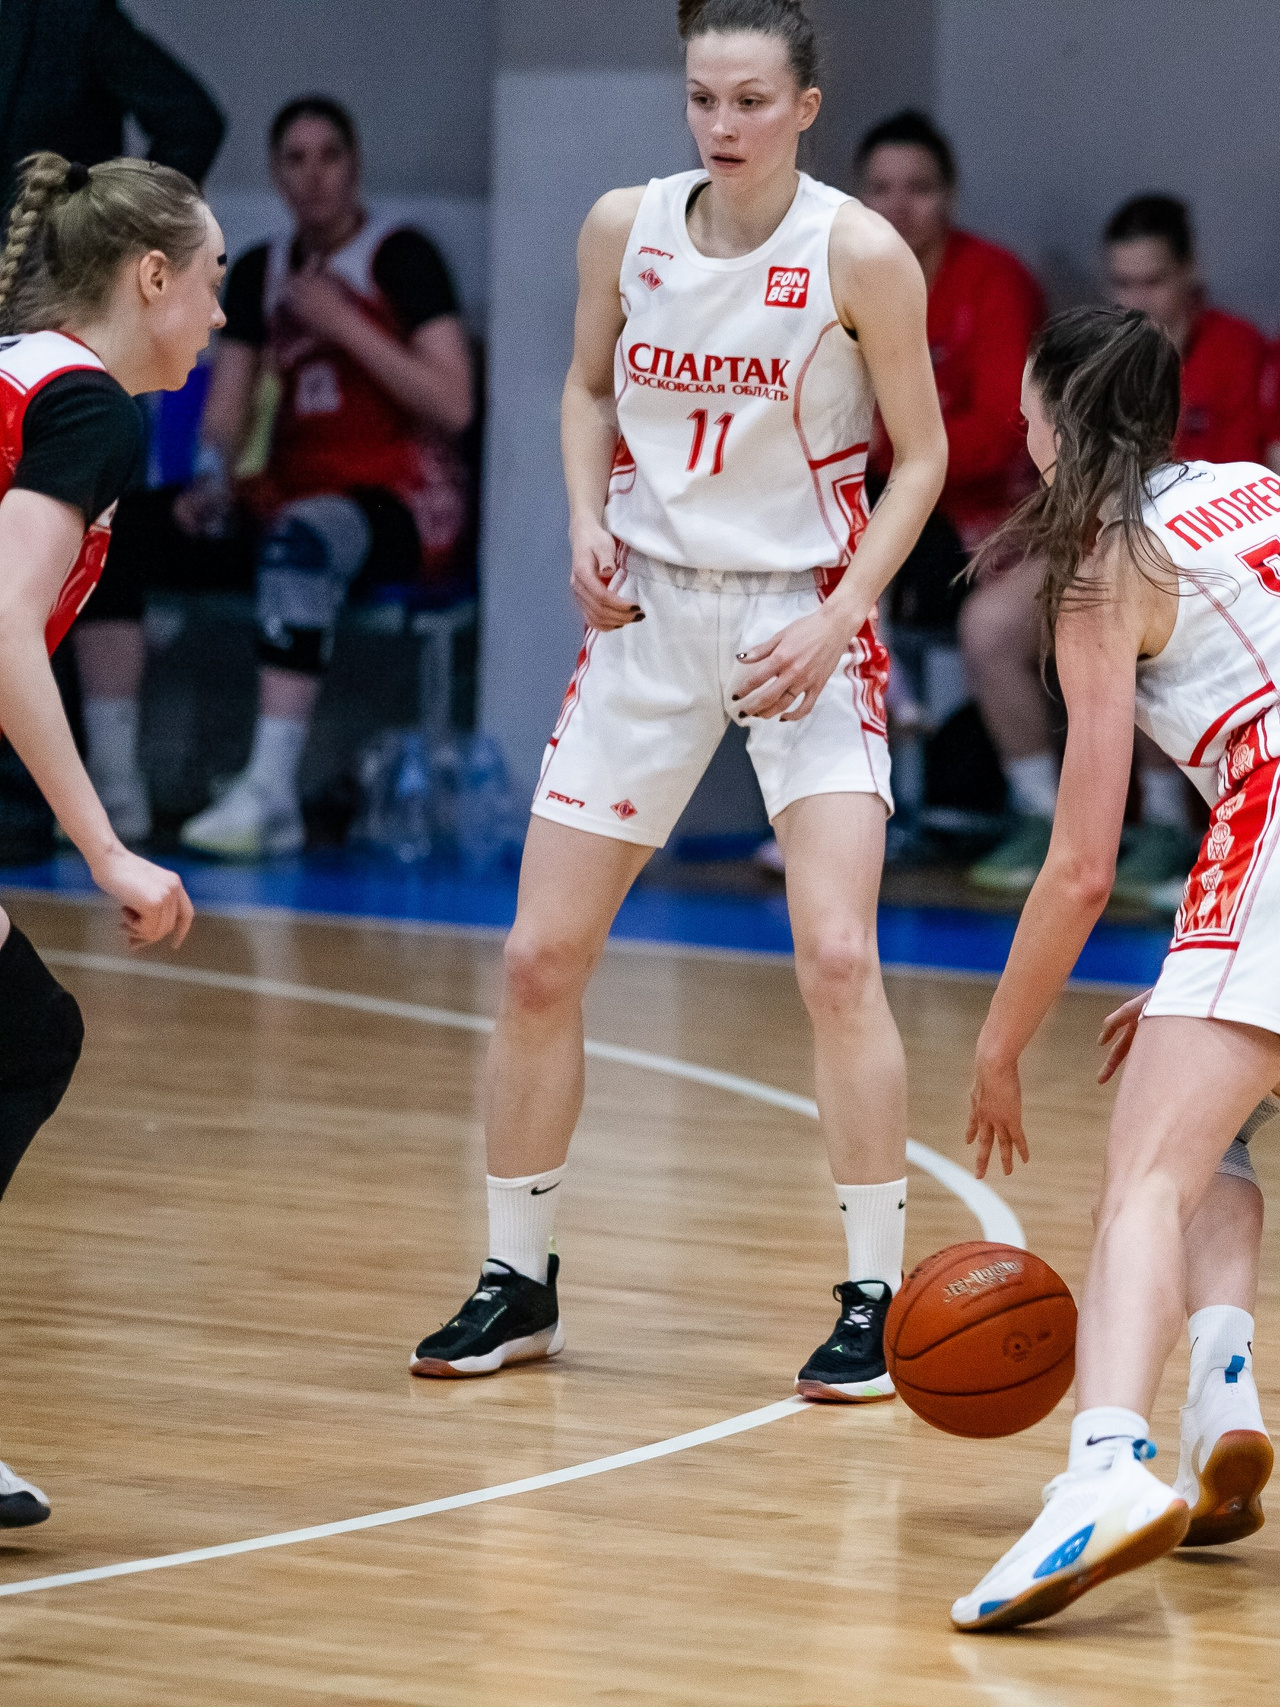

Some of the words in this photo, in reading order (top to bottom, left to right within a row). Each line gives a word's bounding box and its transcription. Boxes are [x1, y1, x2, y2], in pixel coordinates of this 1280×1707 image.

[770, 270, 808, 287] FON
[767, 286, 806, 304] BET
[628, 342, 791, 388] СПАРТАК
[628, 370, 725, 394] МОСКОВСКАЯ
[732, 384, 789, 402] ОБЛАСТЬ
[685, 408, 735, 477] 11
